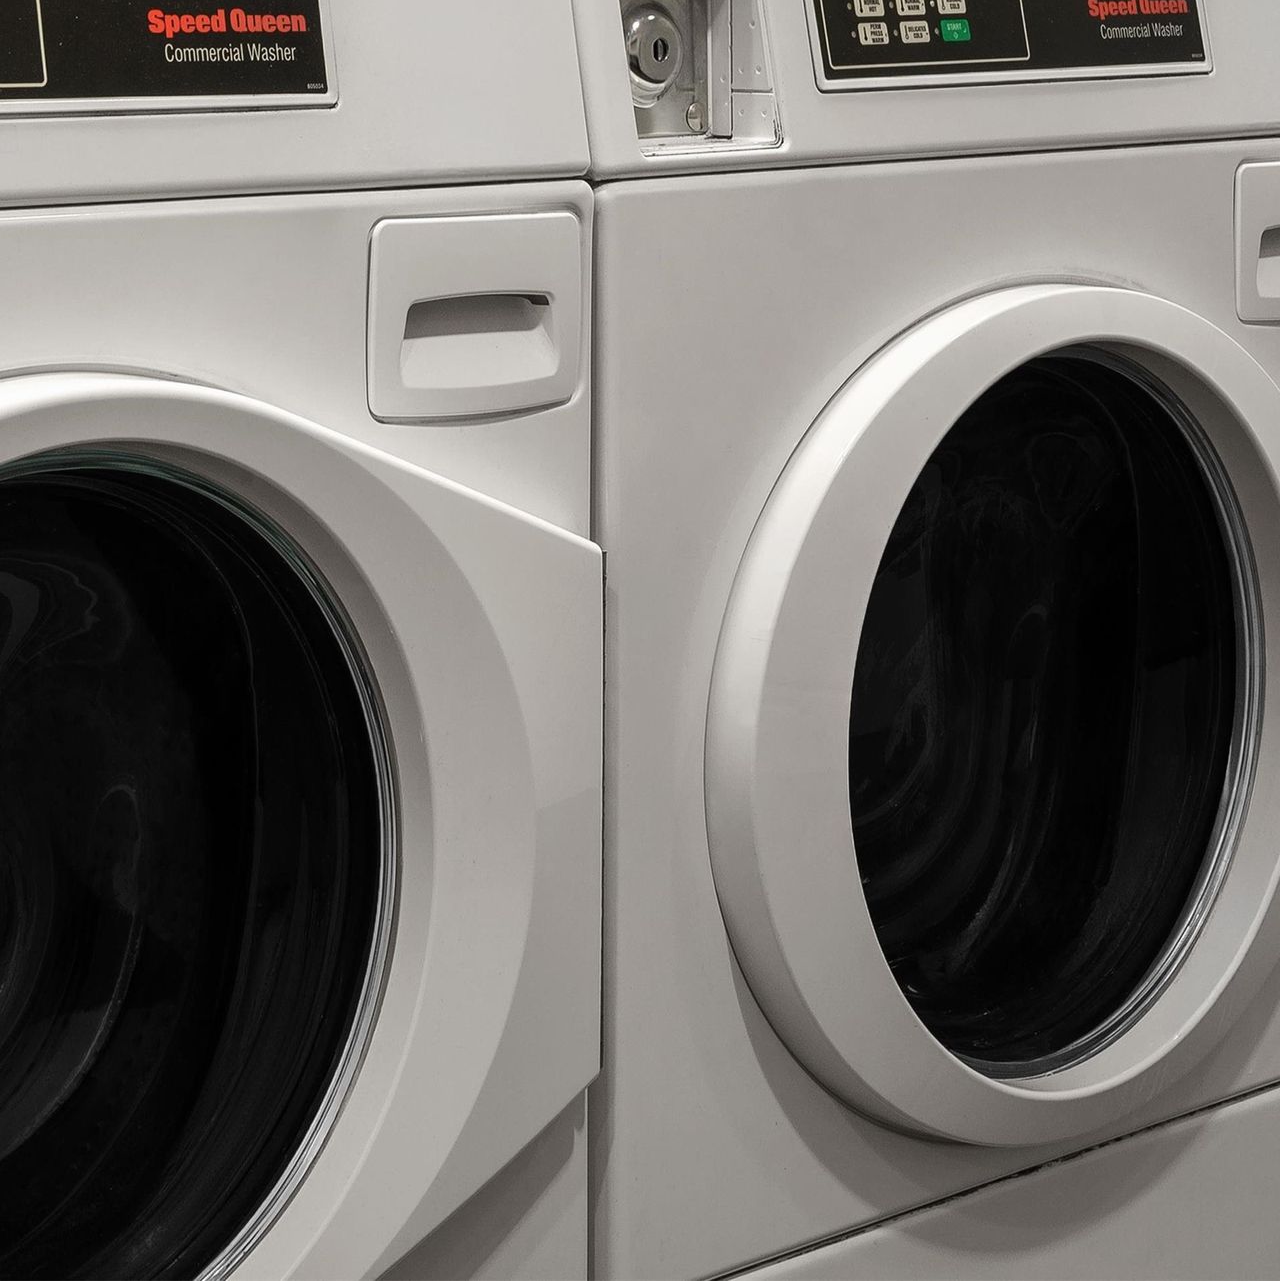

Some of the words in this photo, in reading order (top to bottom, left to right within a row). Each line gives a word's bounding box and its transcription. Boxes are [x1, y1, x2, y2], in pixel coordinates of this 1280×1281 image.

[147, 8, 227, 38] Speed
[229, 8, 307, 33] Queen
[1100, 23, 1151, 39] Commercial
[1151, 22, 1183, 37] Washer
[164, 43, 244, 62] Commercial
[247, 43, 296, 62] Washer
